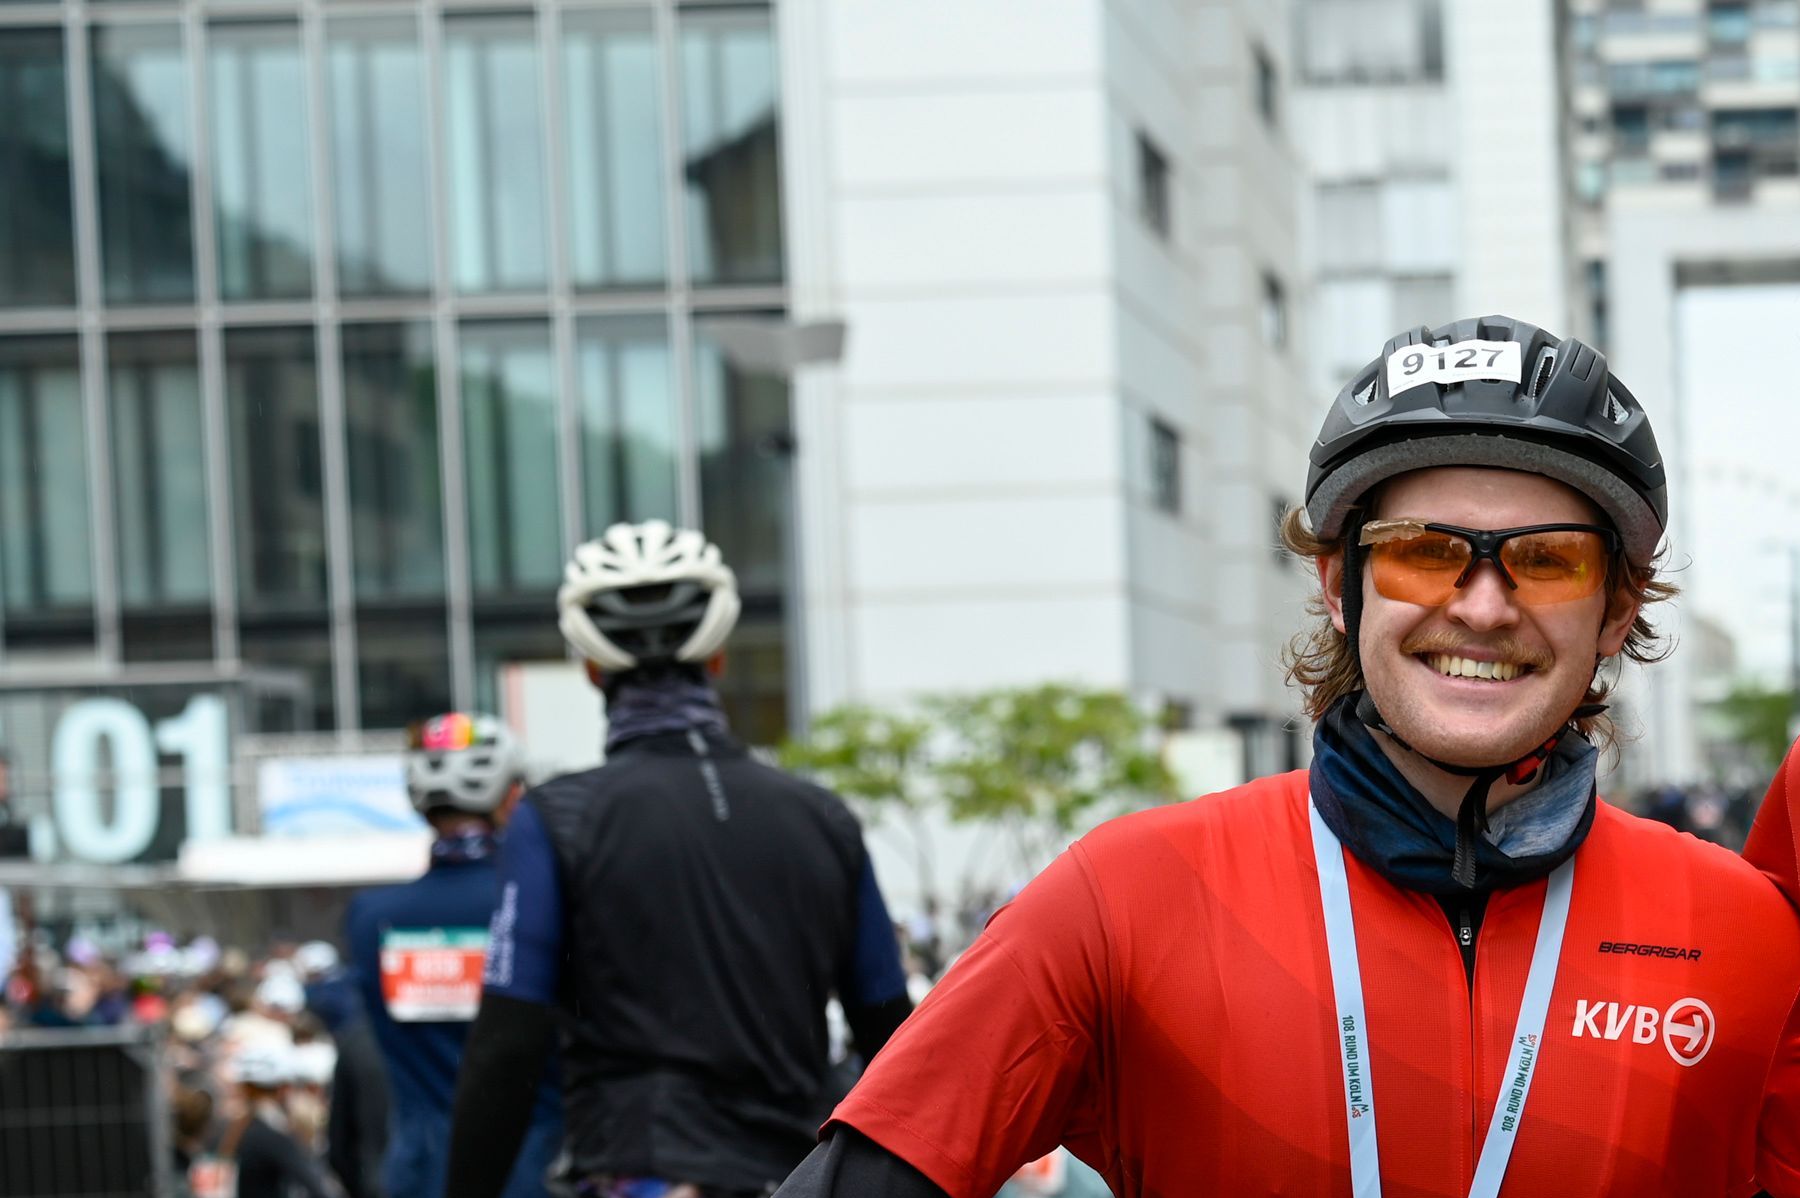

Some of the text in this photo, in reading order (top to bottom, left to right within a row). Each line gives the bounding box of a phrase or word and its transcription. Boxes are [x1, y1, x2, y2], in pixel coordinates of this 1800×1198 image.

[1402, 348, 1504, 376] 9127
[1598, 941, 1702, 961] BERGRISAR
[1342, 1015, 1355, 1035] 108.
[1571, 999, 1660, 1045] KVB
[1344, 1035, 1358, 1060] RUND
[1347, 1062, 1360, 1077] UM
[1513, 1072, 1528, 1088] UM
[1507, 1087, 1523, 1114] RUND
[1501, 1115, 1517, 1132] 108.
